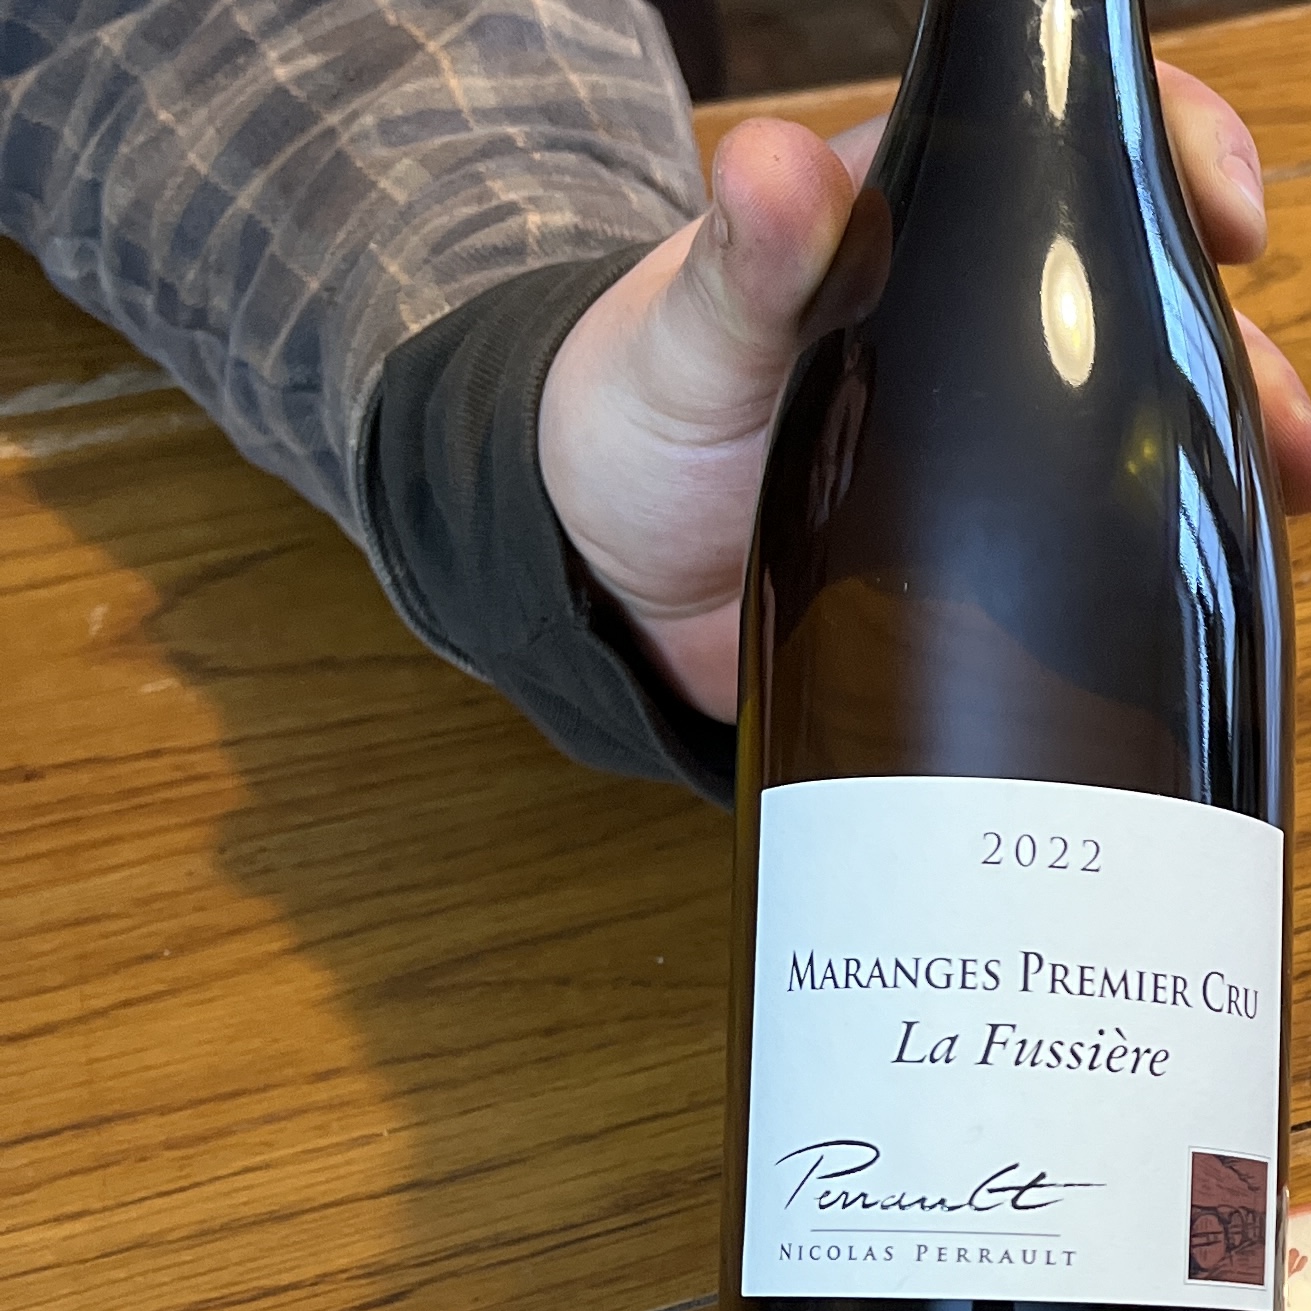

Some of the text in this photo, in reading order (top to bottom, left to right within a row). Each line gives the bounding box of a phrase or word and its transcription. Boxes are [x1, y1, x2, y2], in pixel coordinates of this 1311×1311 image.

[980, 831, 1102, 873] 2022
[787, 949, 1259, 1020] MARANGES PREMIER CRU
[891, 1020, 1171, 1078] La Fussière
[778, 1242, 1078, 1267] NICOLAS PERRAULT
